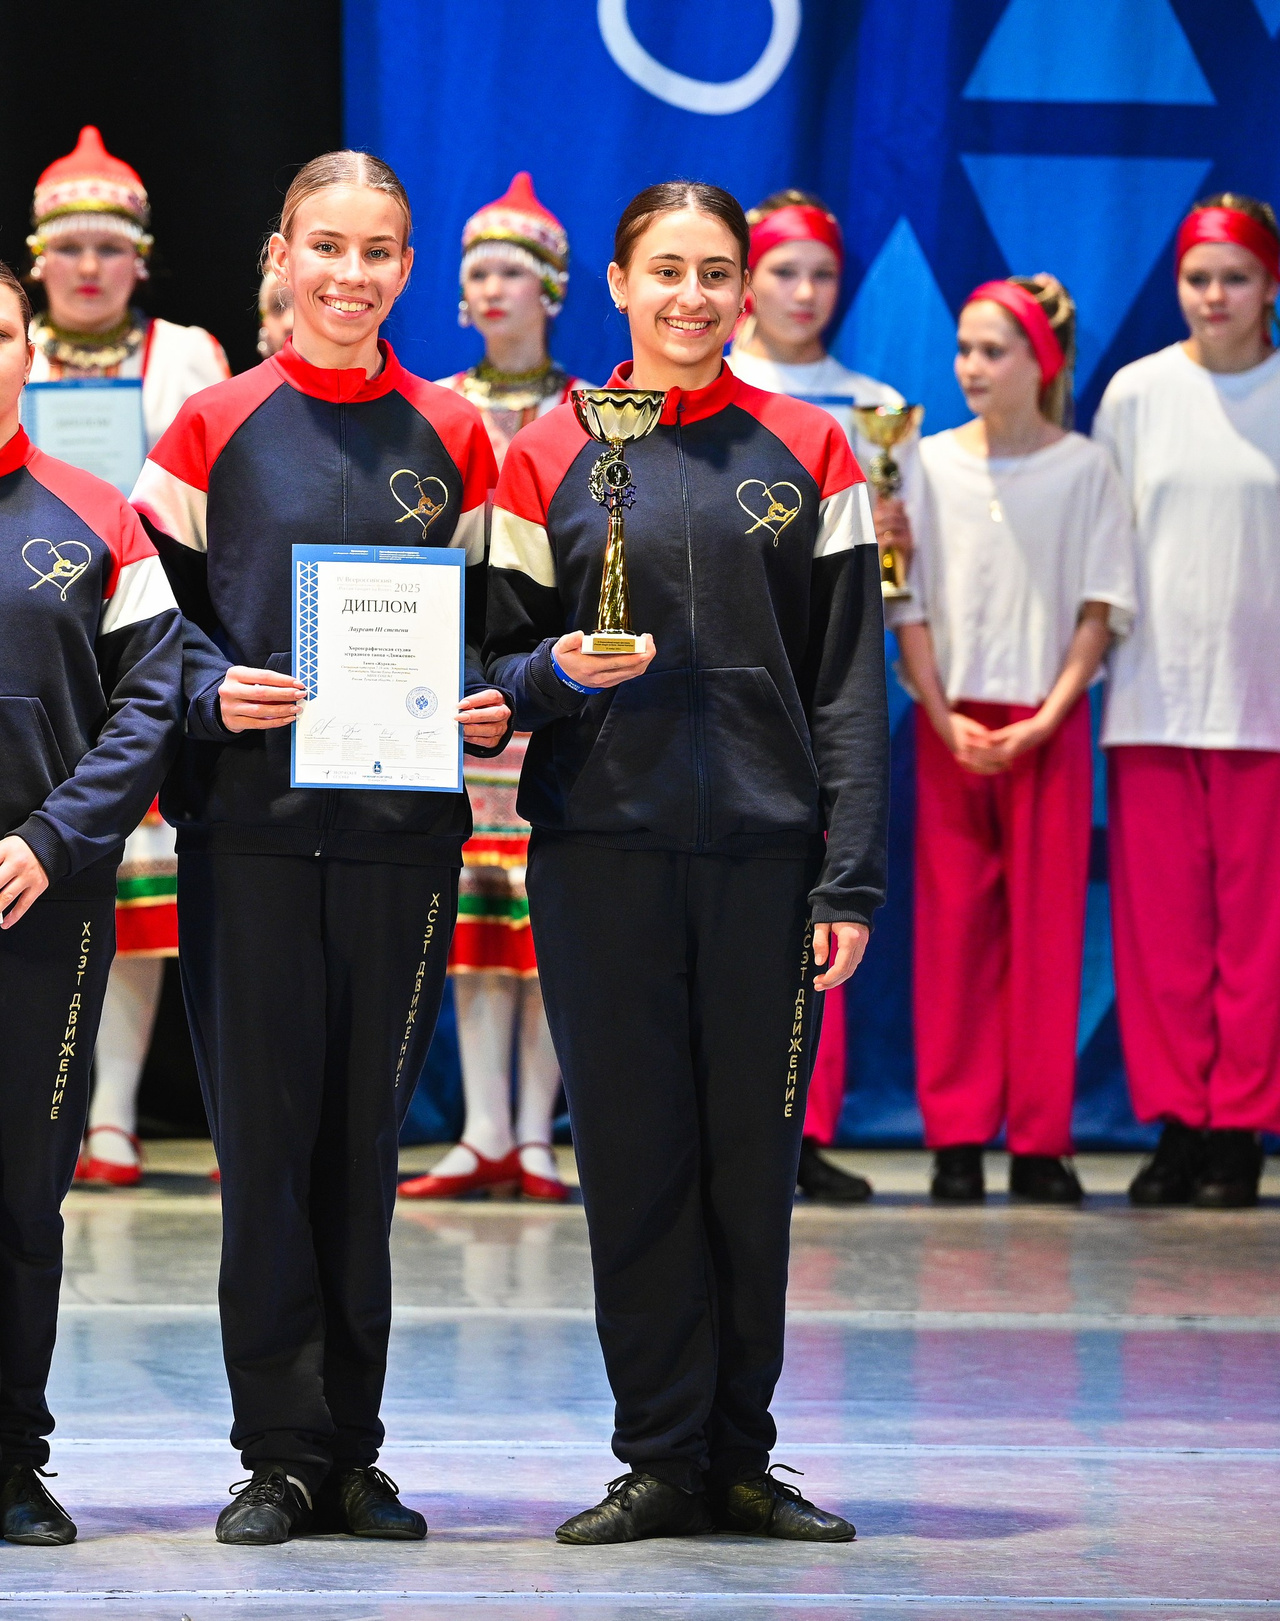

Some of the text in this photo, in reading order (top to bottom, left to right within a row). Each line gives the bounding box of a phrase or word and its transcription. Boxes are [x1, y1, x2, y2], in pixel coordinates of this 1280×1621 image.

[341, 598, 418, 615] ДИПЛОМ
[394, 582, 421, 593] 2025
[50, 921, 92, 1120] ХСЭТ ДВИЖЕНИЕ
[393, 892, 440, 1088] ХСЭТ ДВИЖЕНИЕ
[784, 917, 812, 1118] ХСЭТ ДВИЖЕНИЕ
